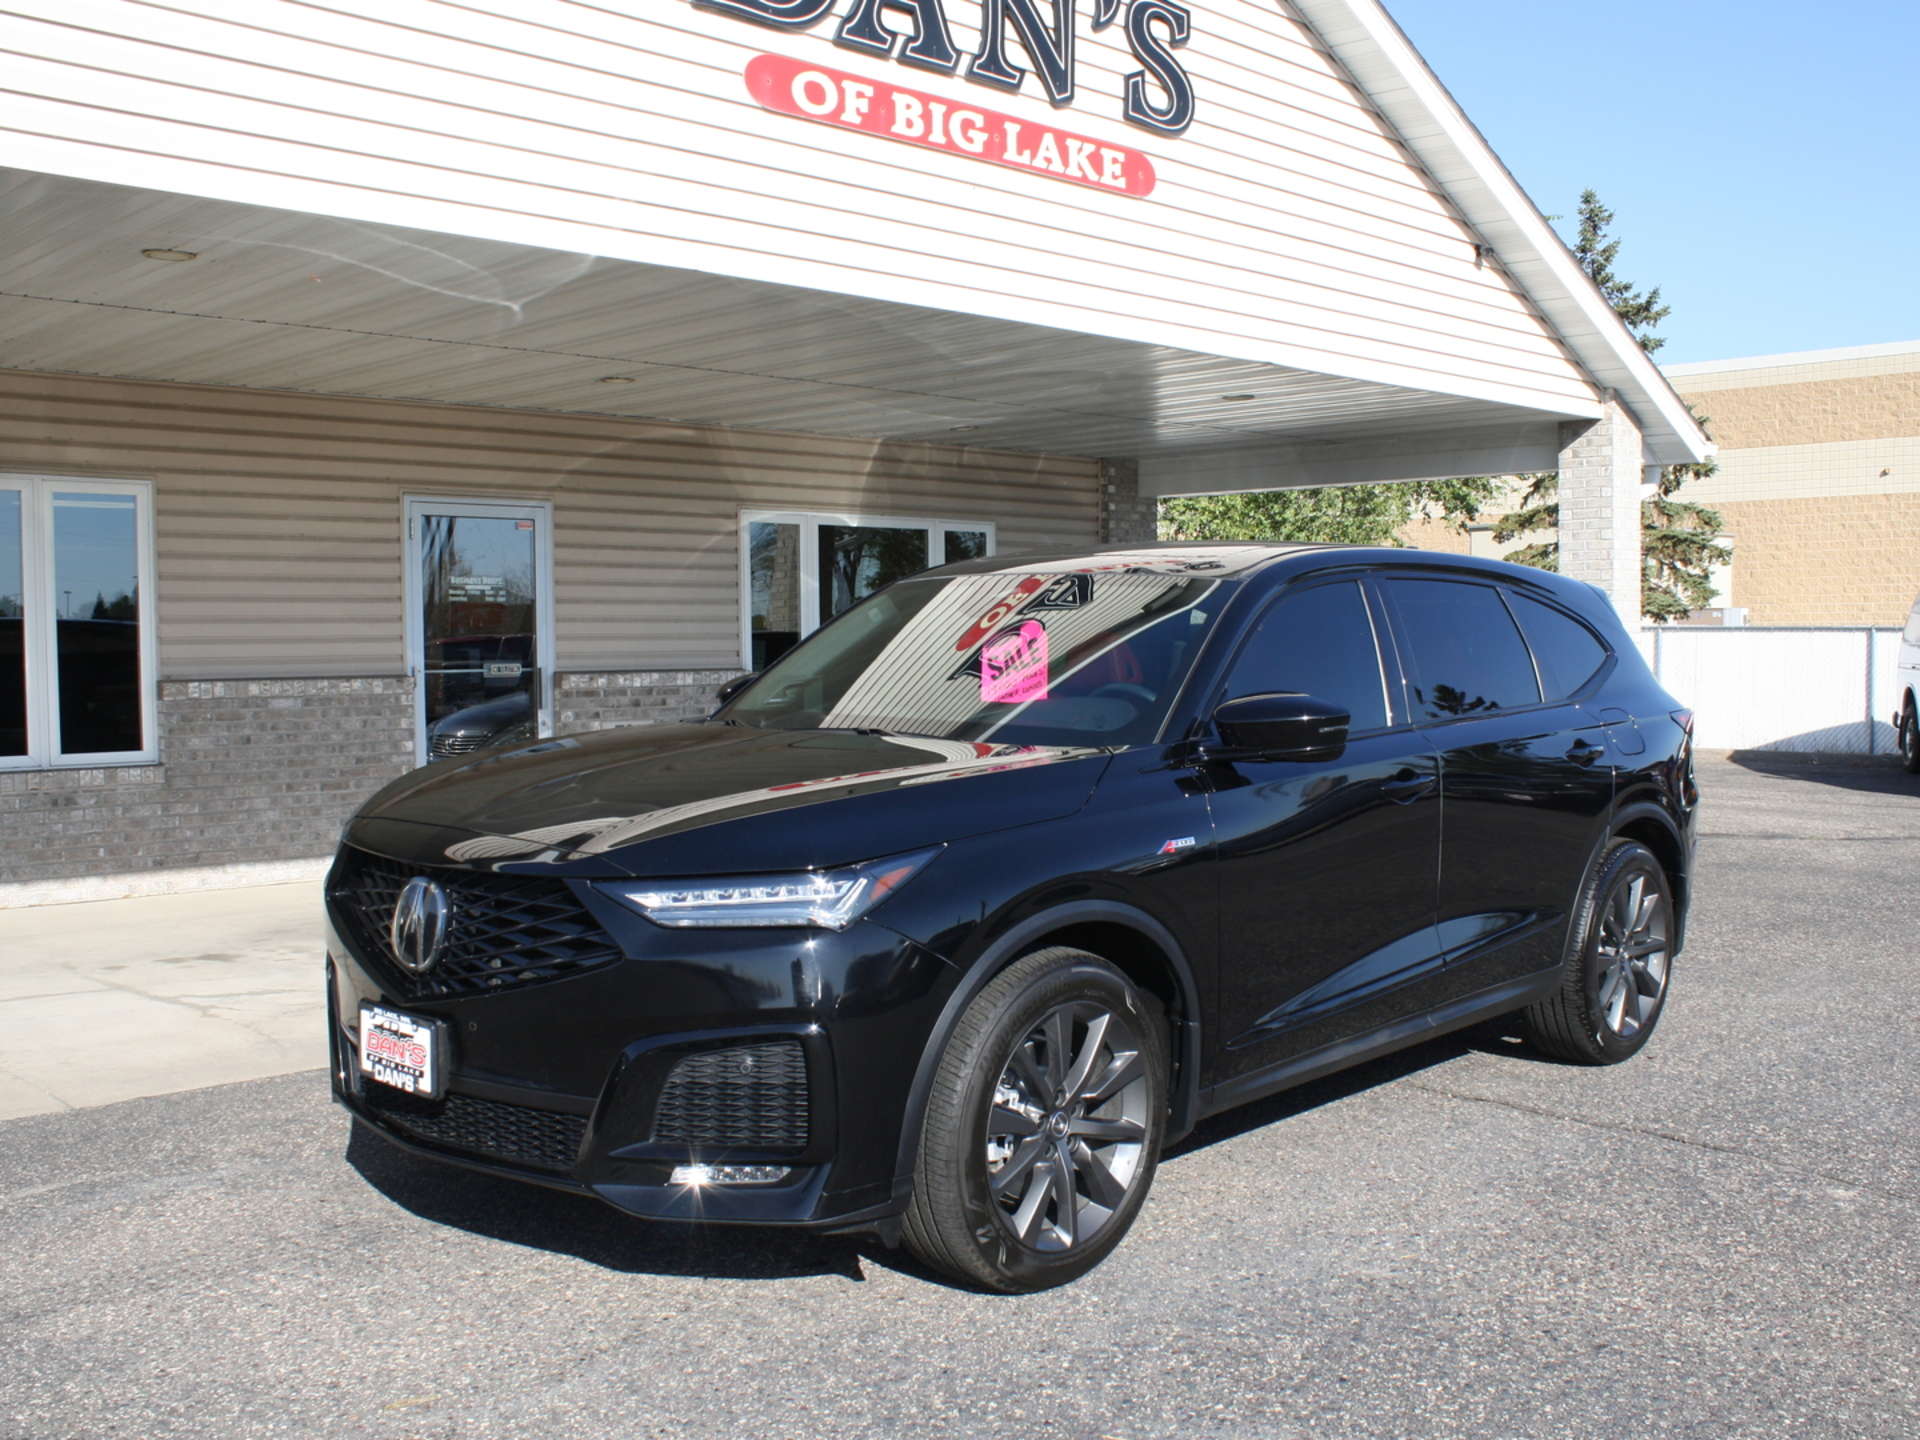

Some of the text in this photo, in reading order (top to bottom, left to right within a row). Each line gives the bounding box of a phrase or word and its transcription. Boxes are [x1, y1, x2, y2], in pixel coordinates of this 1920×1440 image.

[790, 70, 1127, 190] OF BIG LAKE
[366, 1030, 427, 1068] DAN'S
[374, 1063, 415, 1092] DAN'S
